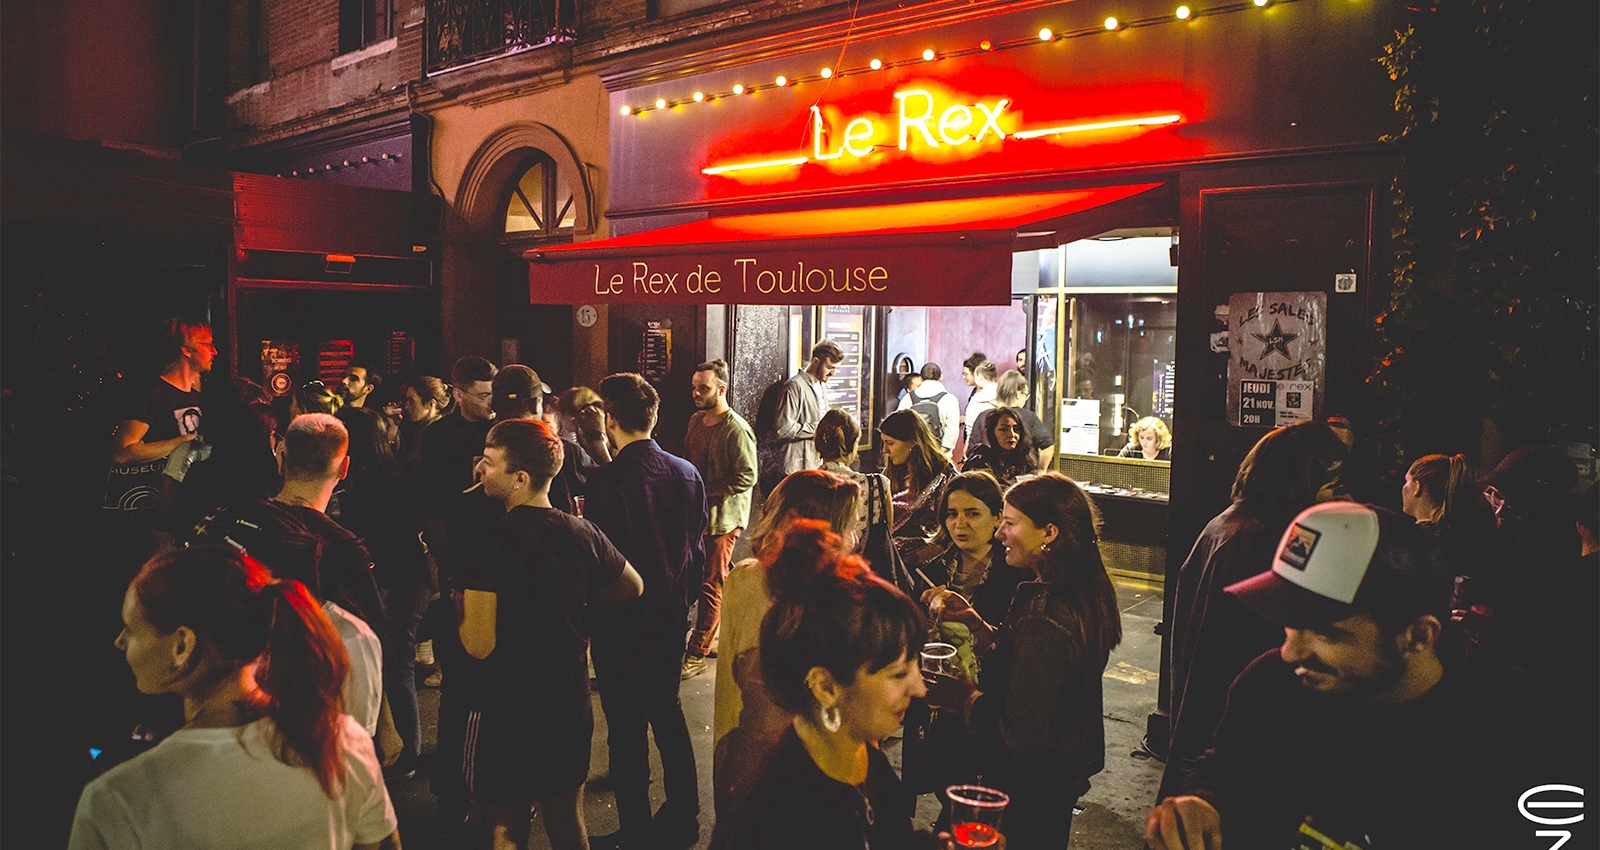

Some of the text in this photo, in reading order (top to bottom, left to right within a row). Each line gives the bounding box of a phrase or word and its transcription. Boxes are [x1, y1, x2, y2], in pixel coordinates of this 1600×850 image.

[810, 88, 1010, 161] Le Rex
[594, 257, 889, 296] Le Rex de Toulouse
[580, 308, 592, 325] 15
[1242, 383, 1271, 394] JEUDI
[1242, 397, 1275, 410] 21 NOV.
[1243, 414, 1261, 424] 20H
